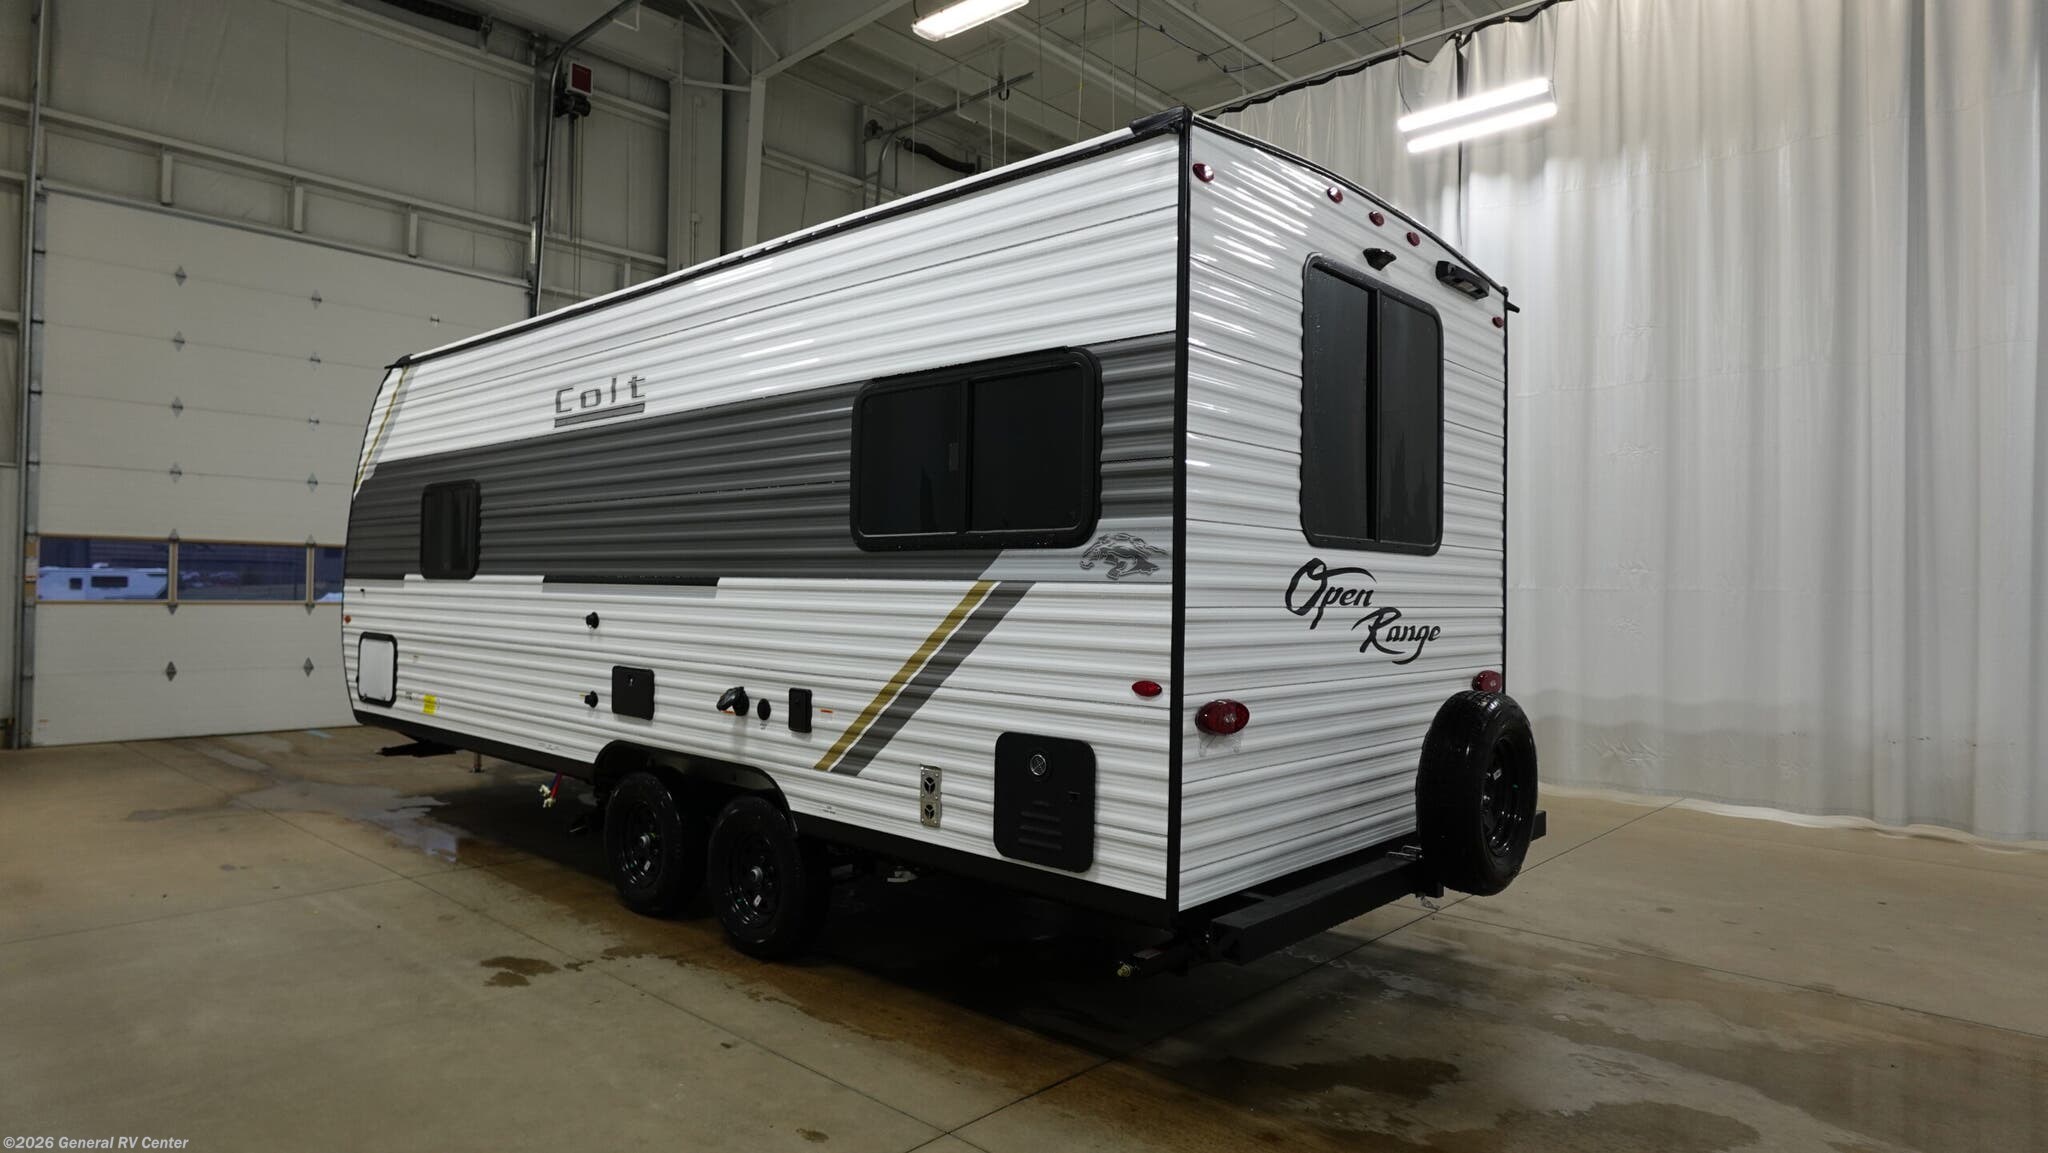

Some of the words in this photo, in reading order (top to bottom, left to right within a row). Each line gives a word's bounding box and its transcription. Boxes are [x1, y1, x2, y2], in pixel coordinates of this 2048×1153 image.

[555, 376, 645, 413] Colt
[1285, 558, 1377, 630] Open
[1351, 607, 1441, 665] Range
